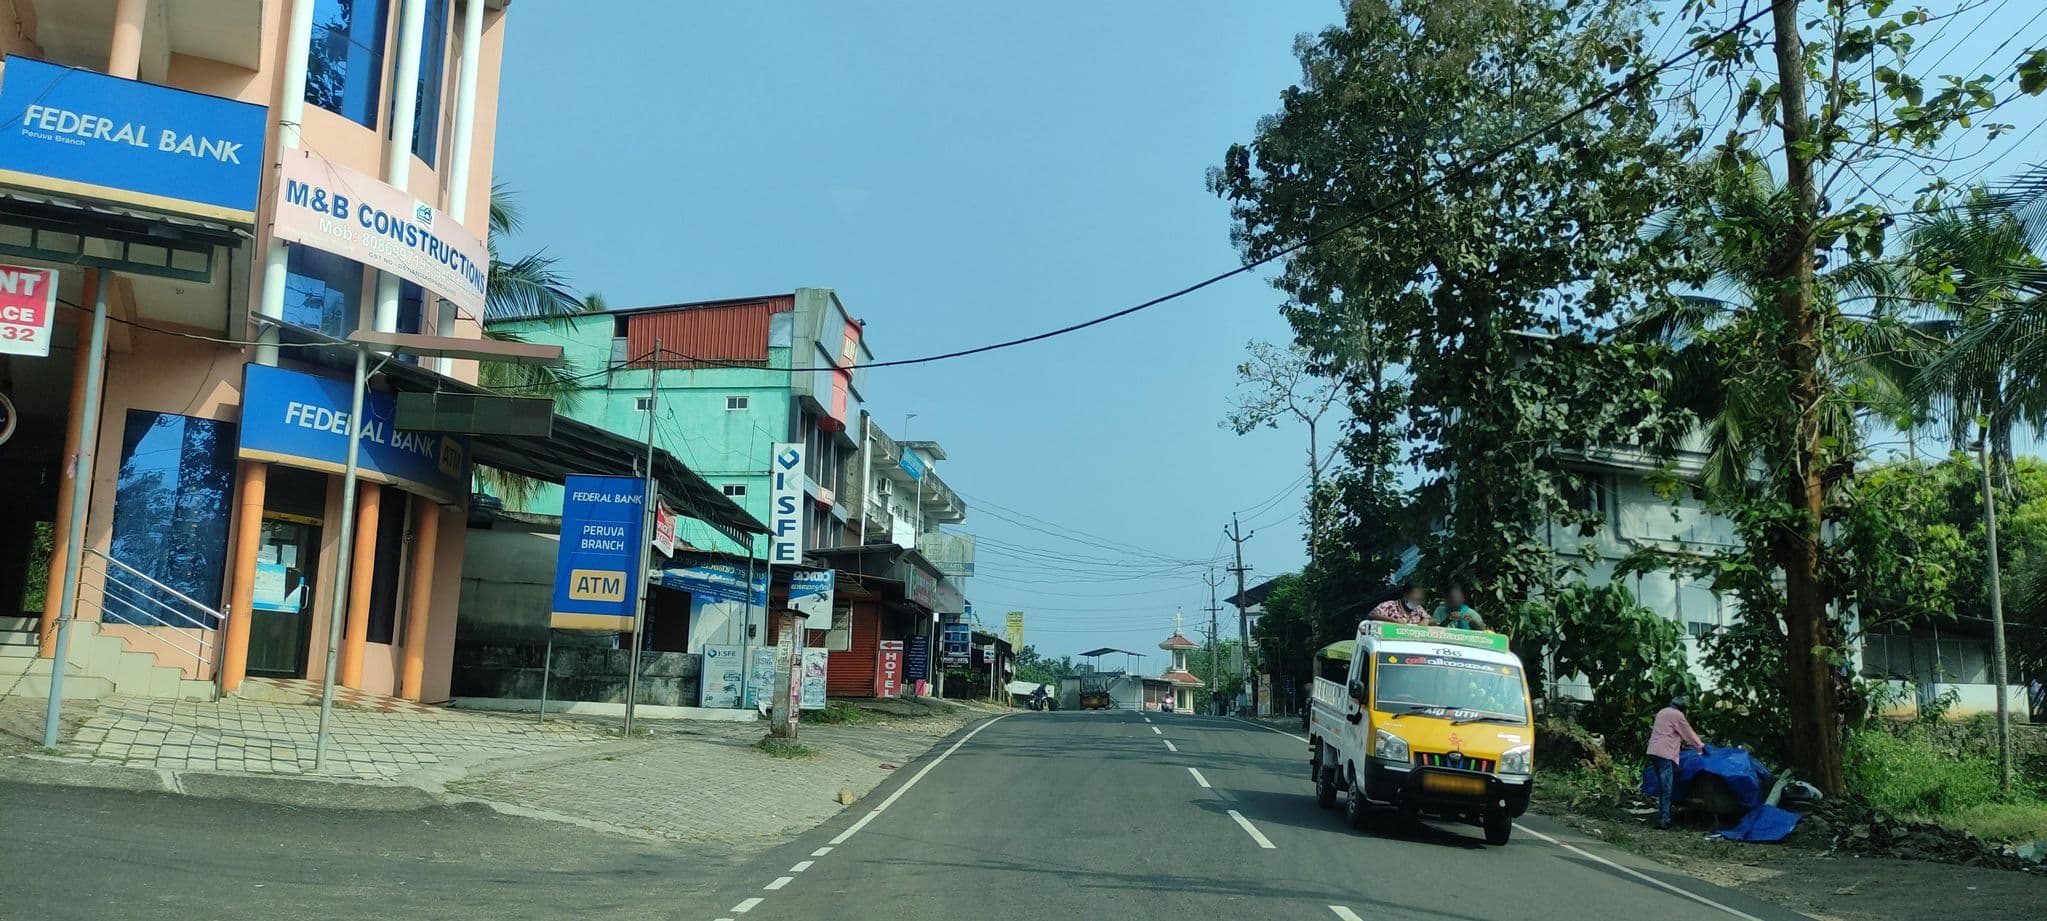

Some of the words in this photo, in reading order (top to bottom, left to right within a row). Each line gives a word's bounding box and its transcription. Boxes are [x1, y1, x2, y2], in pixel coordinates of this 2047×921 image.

[22, 128, 52, 141] Peruva
[55, 134, 86, 147] Branch
[24, 104, 149, 148] FEDERAL
[159, 129, 243, 165] BANK
[286, 178, 349, 220] M&B
[358, 203, 485, 294] CONSTRUCTIONS
[0, 306, 35, 323] CE
[285, 401, 385, 444] FEDEAL
[390, 431, 436, 459] BANK
[572, 491, 612, 503] FEDERAL
[614, 494, 642, 505] BANK
[583, 525, 625, 537] PERUVA
[581, 539, 624, 551] BRANCH
[577, 576, 620, 595] ATM
[885, 652, 897, 697] HOTEL
